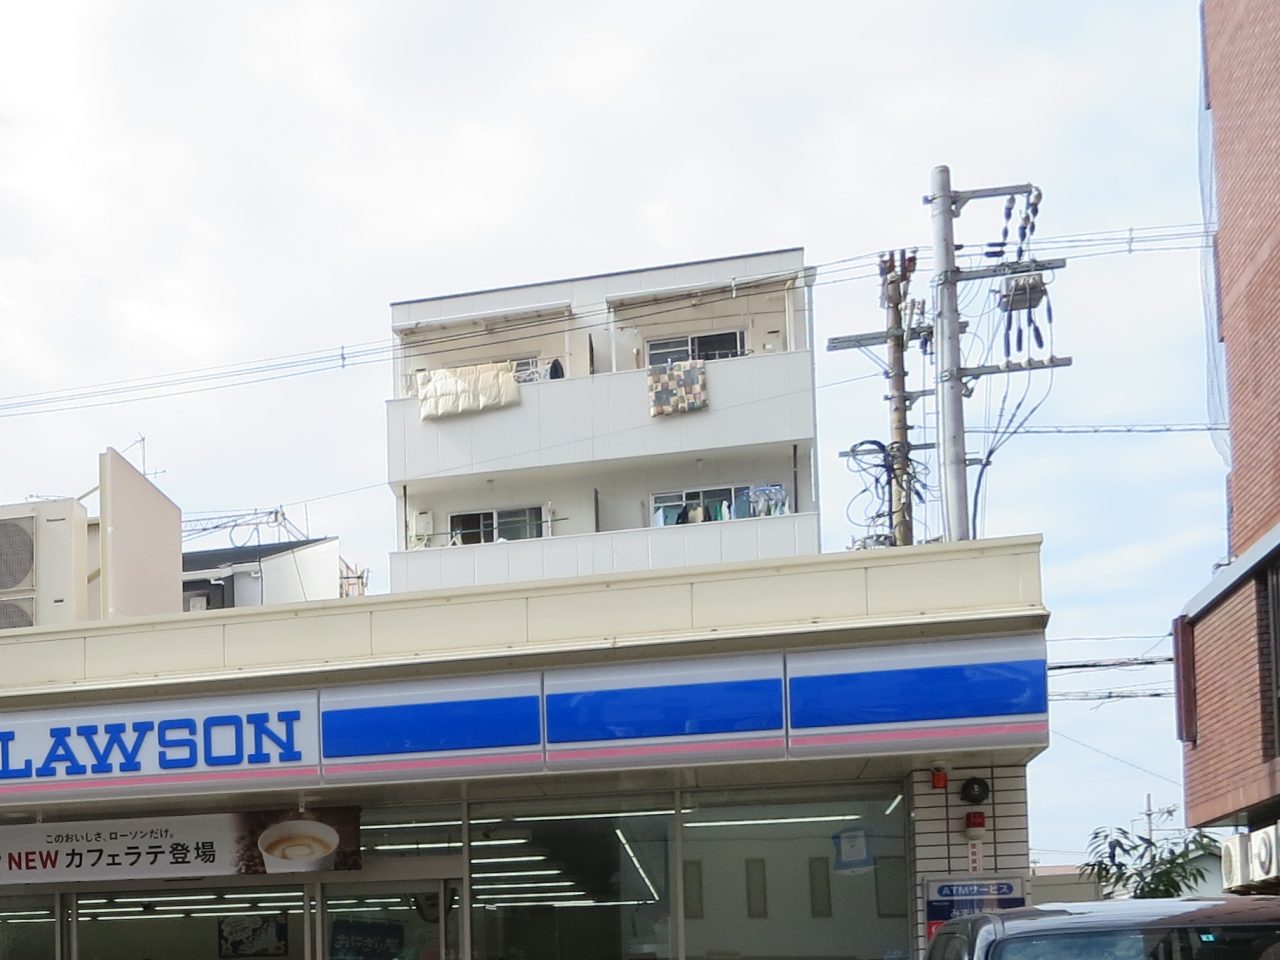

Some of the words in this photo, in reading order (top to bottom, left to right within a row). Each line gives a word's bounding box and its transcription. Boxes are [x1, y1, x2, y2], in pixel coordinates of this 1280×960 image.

[45, 828, 175, 844] このおいしさ、ローソンだけ。
[7, 850, 59, 871] NEW
[65, 841, 216, 869] カフェラテ登場
[942, 884, 1010, 896] ATMサービス
